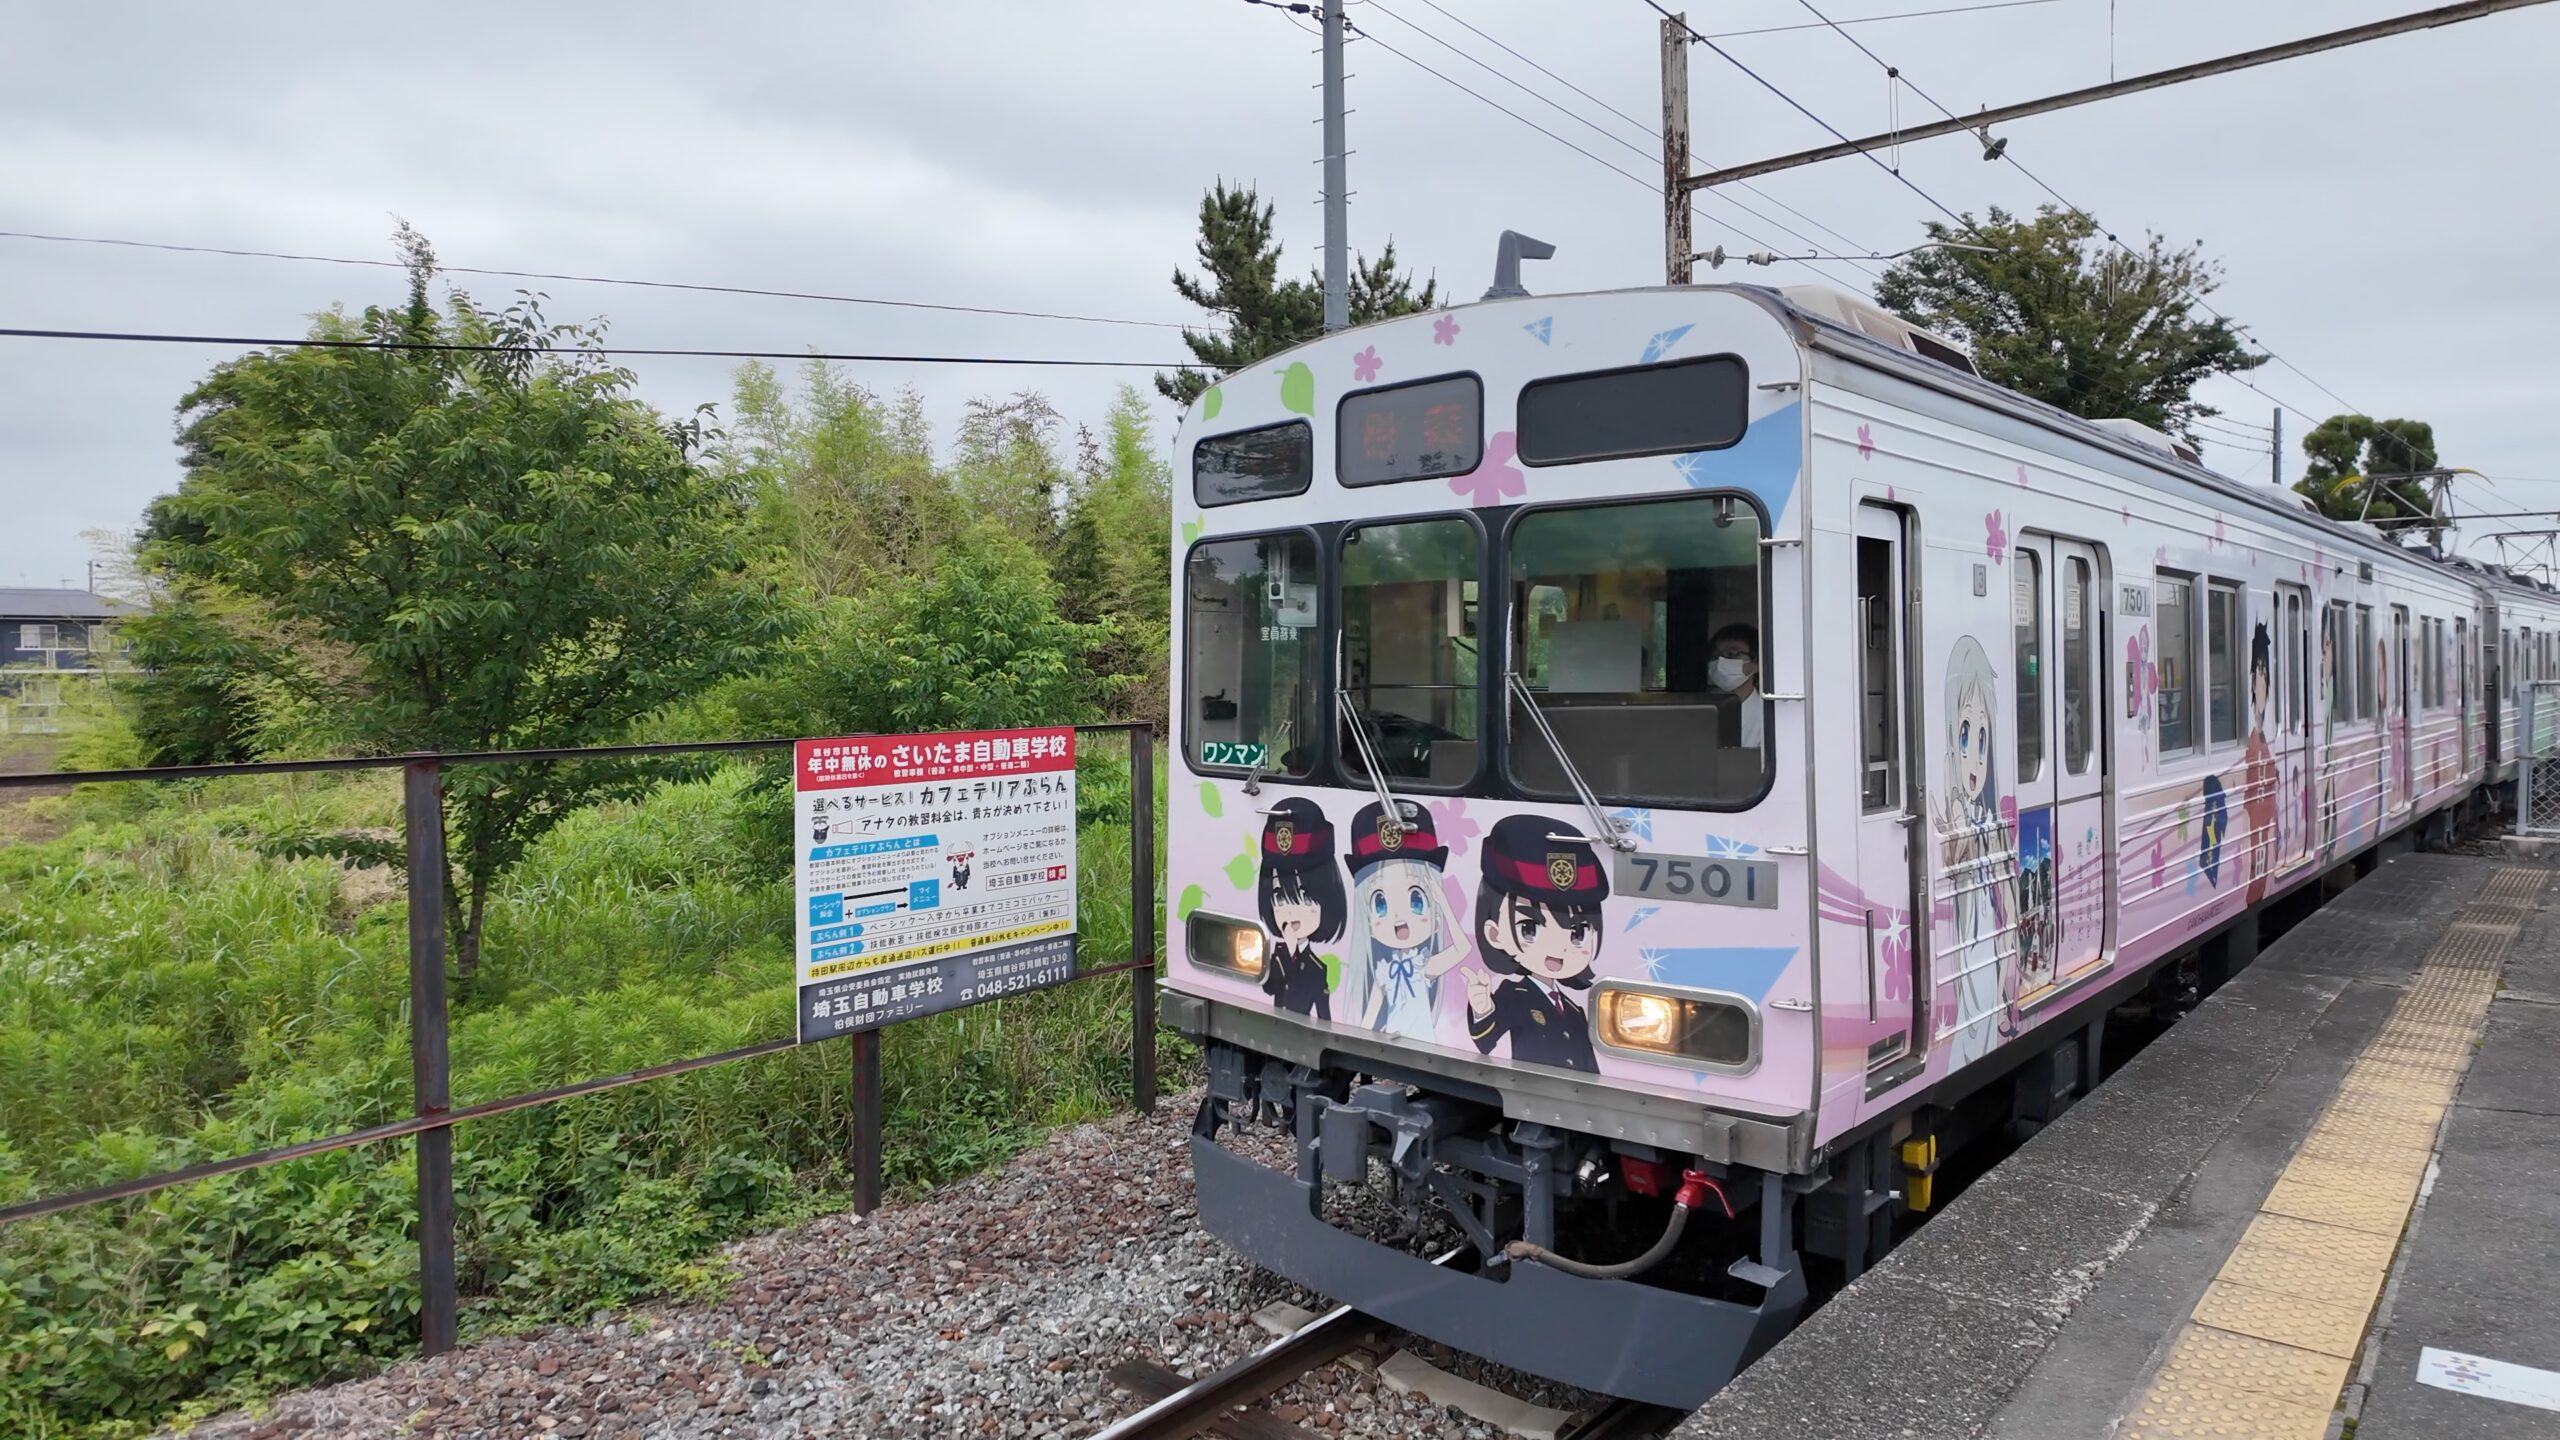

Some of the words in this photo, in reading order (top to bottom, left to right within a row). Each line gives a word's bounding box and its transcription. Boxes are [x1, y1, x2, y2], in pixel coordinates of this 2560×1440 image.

[2123, 587, 2148, 613] 7501
[892, 735, 1067, 767] さいたま自動車学校
[1204, 742, 1265, 766] ワンマン
[988, 871, 1045, 888] 埼玉自動車学校
[1631, 858, 1755, 901] 7501
[1051, 952, 1067, 963] 330
[977, 965, 1068, 998] 048-521-6111
[812, 976, 944, 1020] 埼玉自動車学校
